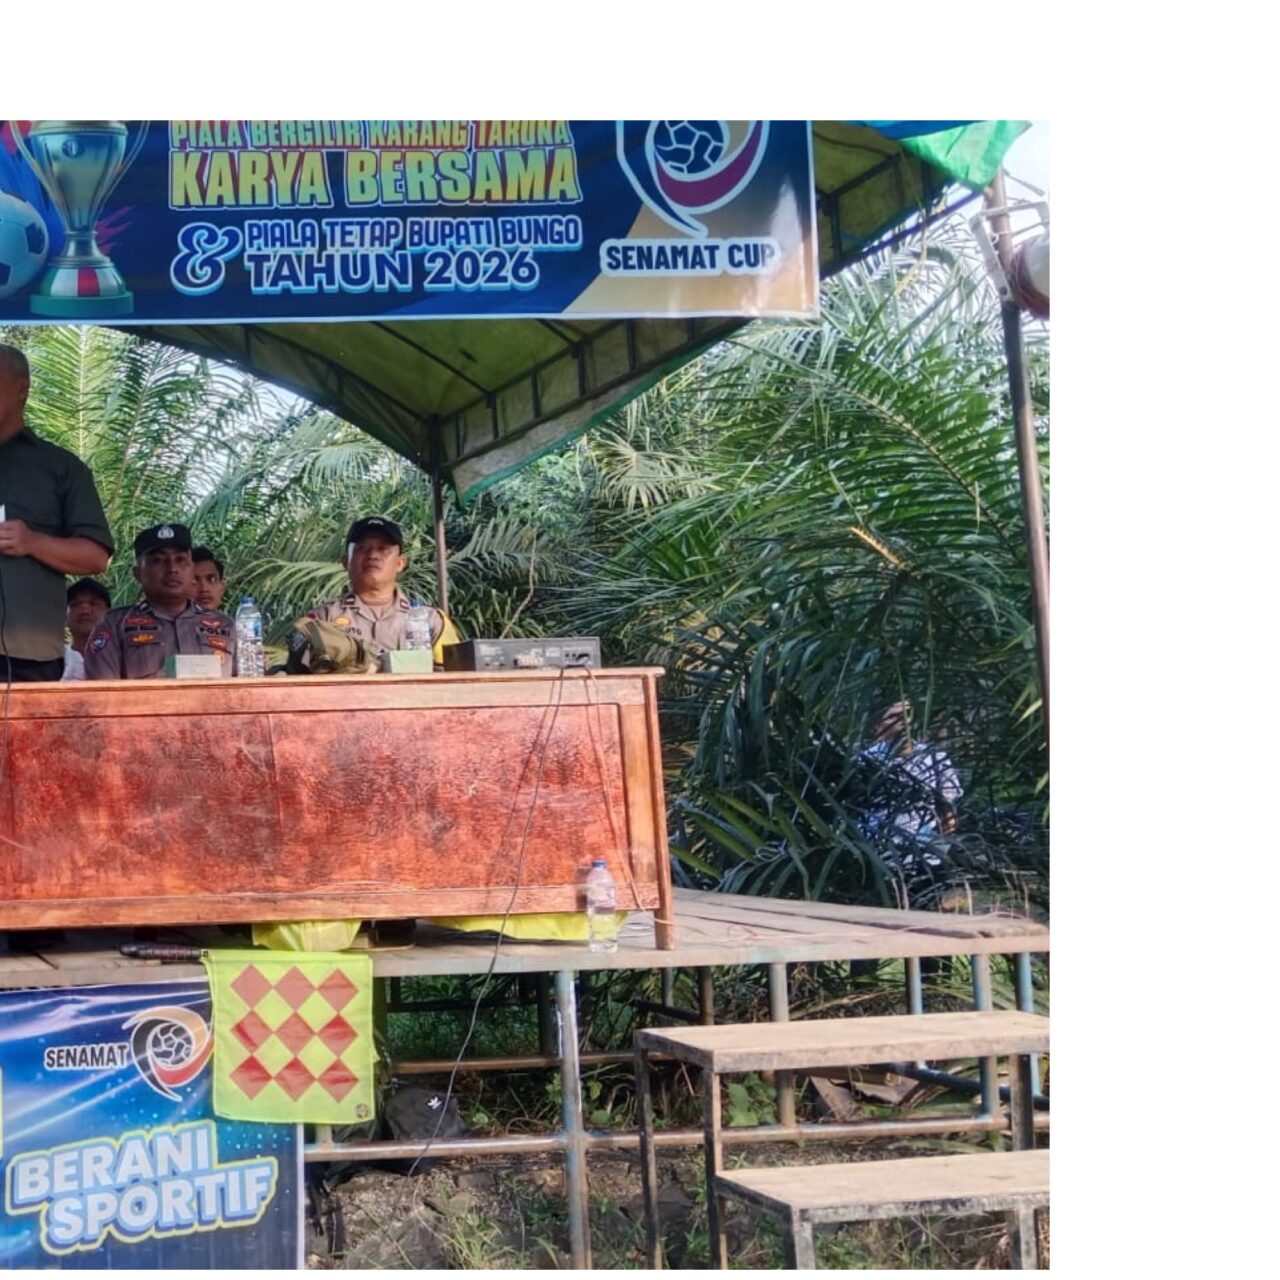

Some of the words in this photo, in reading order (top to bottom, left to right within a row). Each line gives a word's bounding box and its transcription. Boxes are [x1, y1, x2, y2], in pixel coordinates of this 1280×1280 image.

[172, 120, 244, 147] PIALA
[250, 120, 363, 147] BERGILIR
[370, 120, 468, 147] KARANG
[475, 120, 570, 146] TARUNA
[171, 150, 330, 206] KARYA
[347, 147, 580, 203] BERSAMA
[245, 221, 317, 249] PIALA
[324, 219, 401, 248] TETAP
[408, 218, 494, 248] BUPATI
[501, 216, 582, 247] BUNGO
[246, 251, 412, 290] TAHUN
[424, 250, 538, 288] 2026
[606, 243, 720, 271] SENAMAT
[728, 242, 777, 270] CUP
[45, 1044, 128, 1068] SENAMAT
[15, 1128, 209, 1201] BERANI
[53, 1166, 272, 1241] SPORTIF
